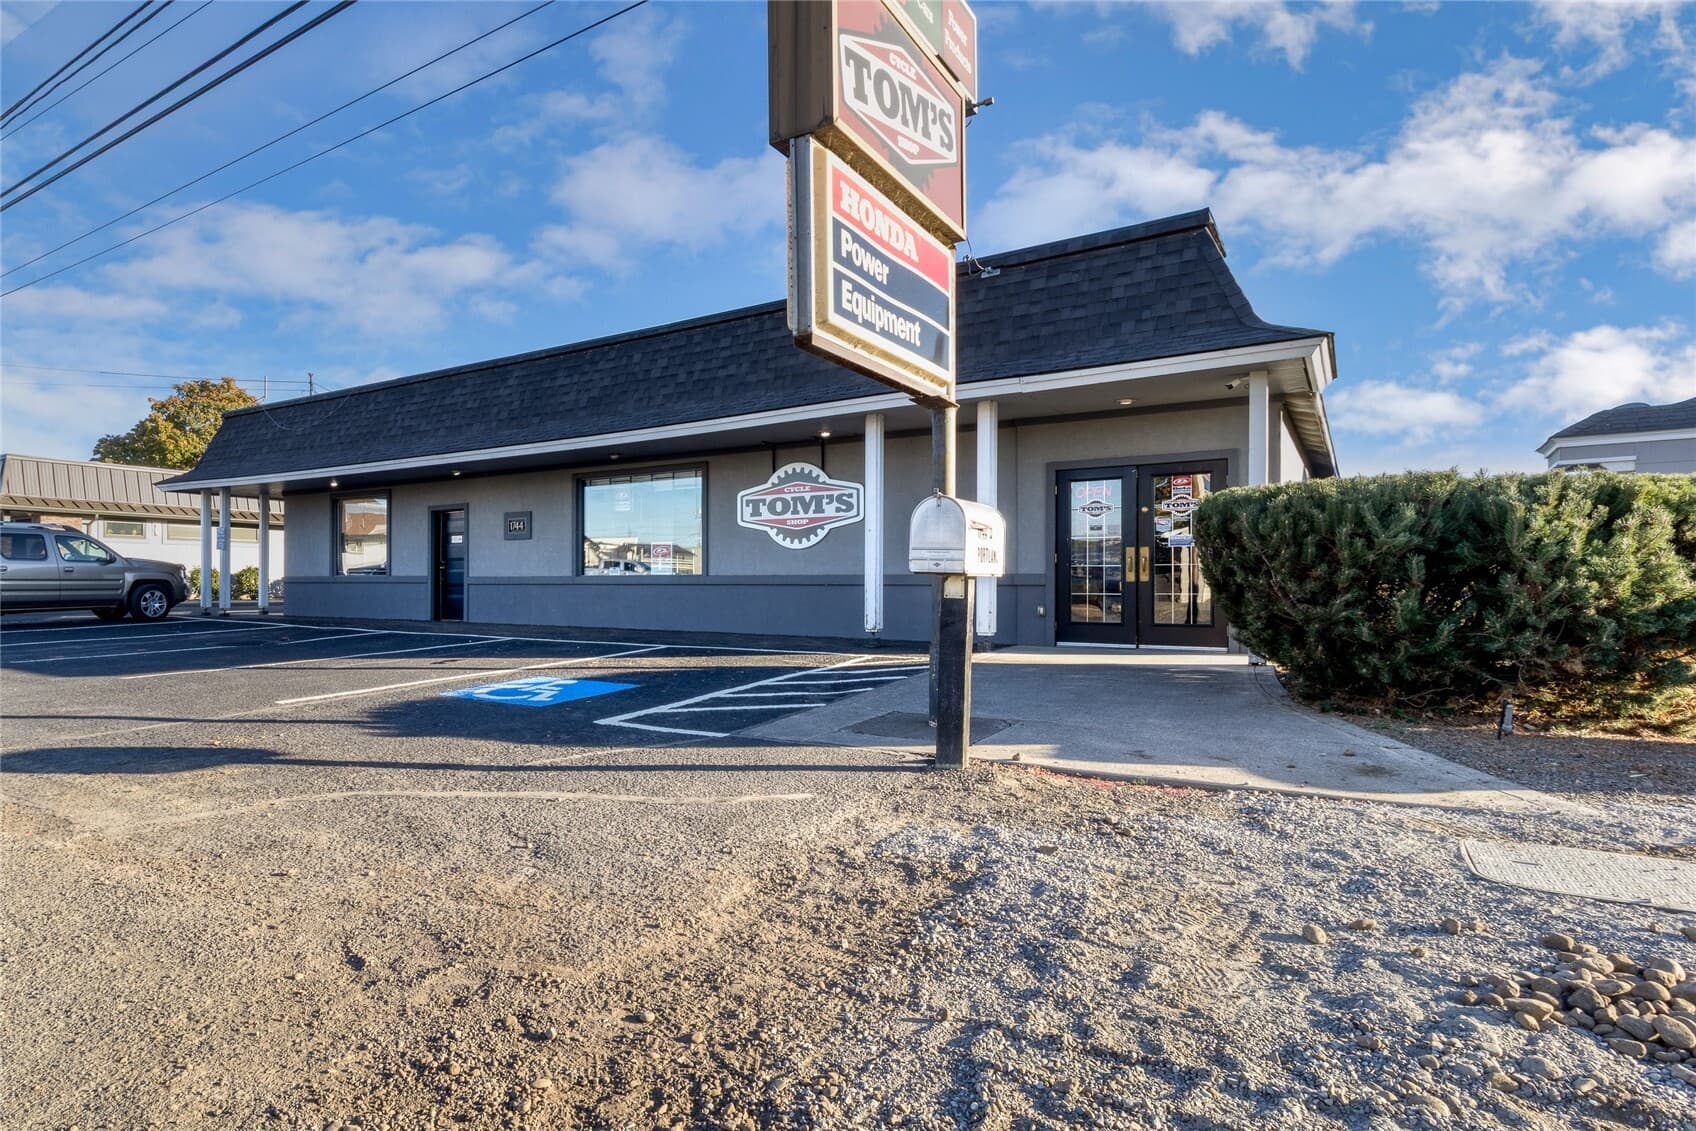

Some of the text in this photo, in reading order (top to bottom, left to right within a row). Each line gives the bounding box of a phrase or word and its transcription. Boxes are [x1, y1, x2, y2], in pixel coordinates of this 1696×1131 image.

[844, 46, 954, 153] TOM'S
[839, 179, 919, 264] HONDA
[840, 227, 890, 286] Power
[840, 279, 921, 348] Equipment
[745, 492, 855, 518] TOM'S
[783, 485, 812, 494] CYCLE
